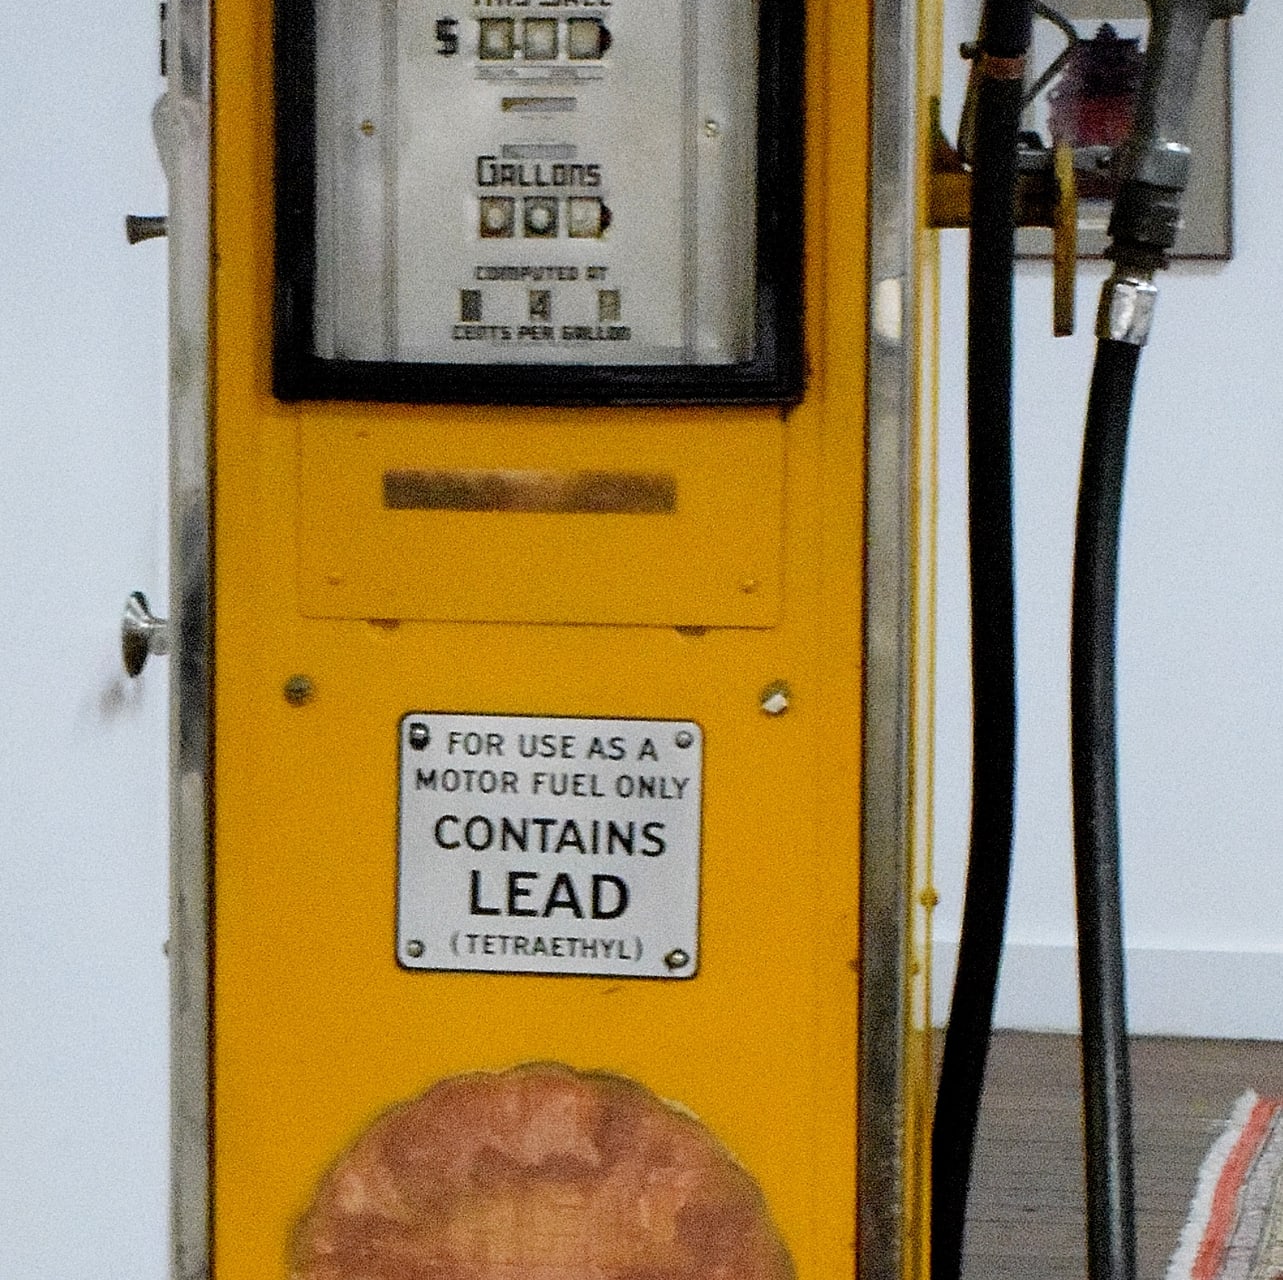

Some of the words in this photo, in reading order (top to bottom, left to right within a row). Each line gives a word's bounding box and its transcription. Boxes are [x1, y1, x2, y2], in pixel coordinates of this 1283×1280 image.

[477, 155, 600, 187] GALLONS
[452, 325, 511, 341] CENTS
[517, 325, 555, 341] PER
[448, 731, 504, 756] FOR
[518, 733, 576, 759] USE
[587, 736, 626, 760] AS
[638, 737, 659, 761] A
[415, 768, 519, 794] MOTOR
[532, 772, 606, 797] FUEL
[615, 775, 690, 799] ONLY
[434, 814, 666, 857] CONTAINS
[469, 870, 631, 920] LEAD
[450, 932, 644, 962] (TETRAETHYL)
